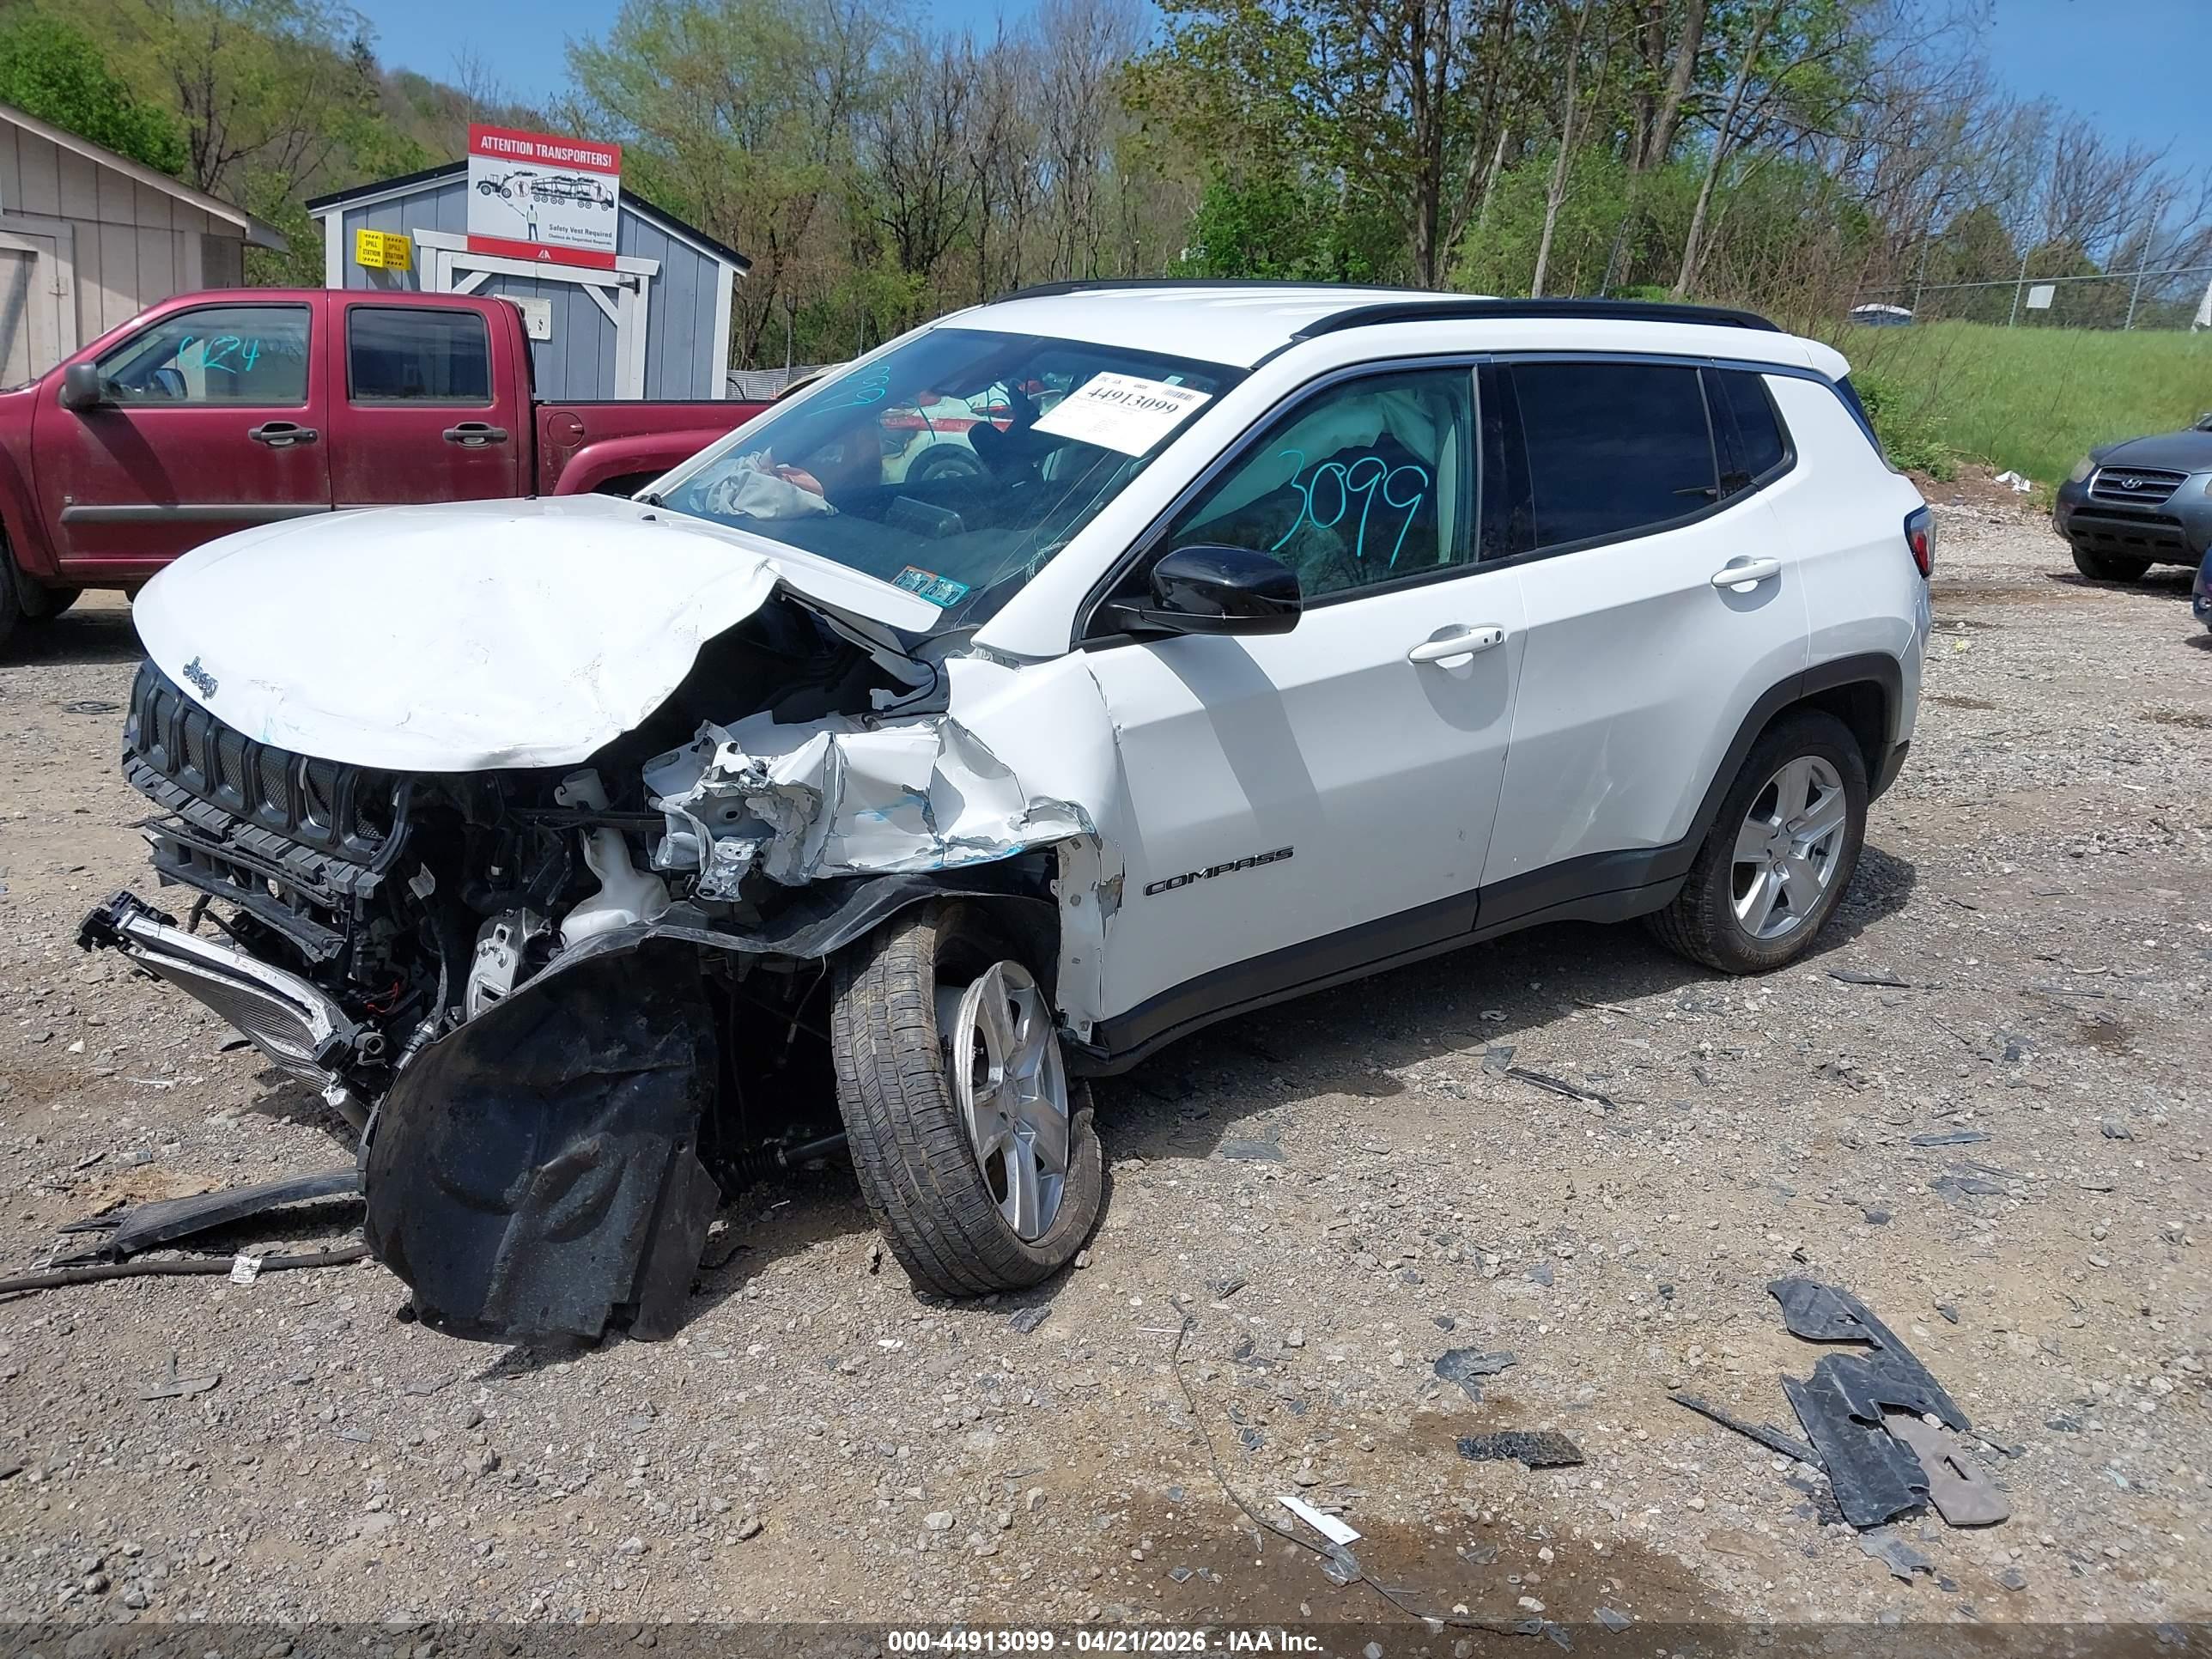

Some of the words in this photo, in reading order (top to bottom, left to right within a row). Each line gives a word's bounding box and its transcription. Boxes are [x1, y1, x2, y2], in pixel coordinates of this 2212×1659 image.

[481, 136, 533, 155] ATTENTION
[536, 143, 612, 167] TRANSPORTERS!
[549, 224, 568, 234] Safety
[585, 228, 612, 238] Required
[1088, 386, 1179, 415] 44913099
[1271, 450, 1428, 570] 3099
[1143, 845, 1294, 896] COMPASS
